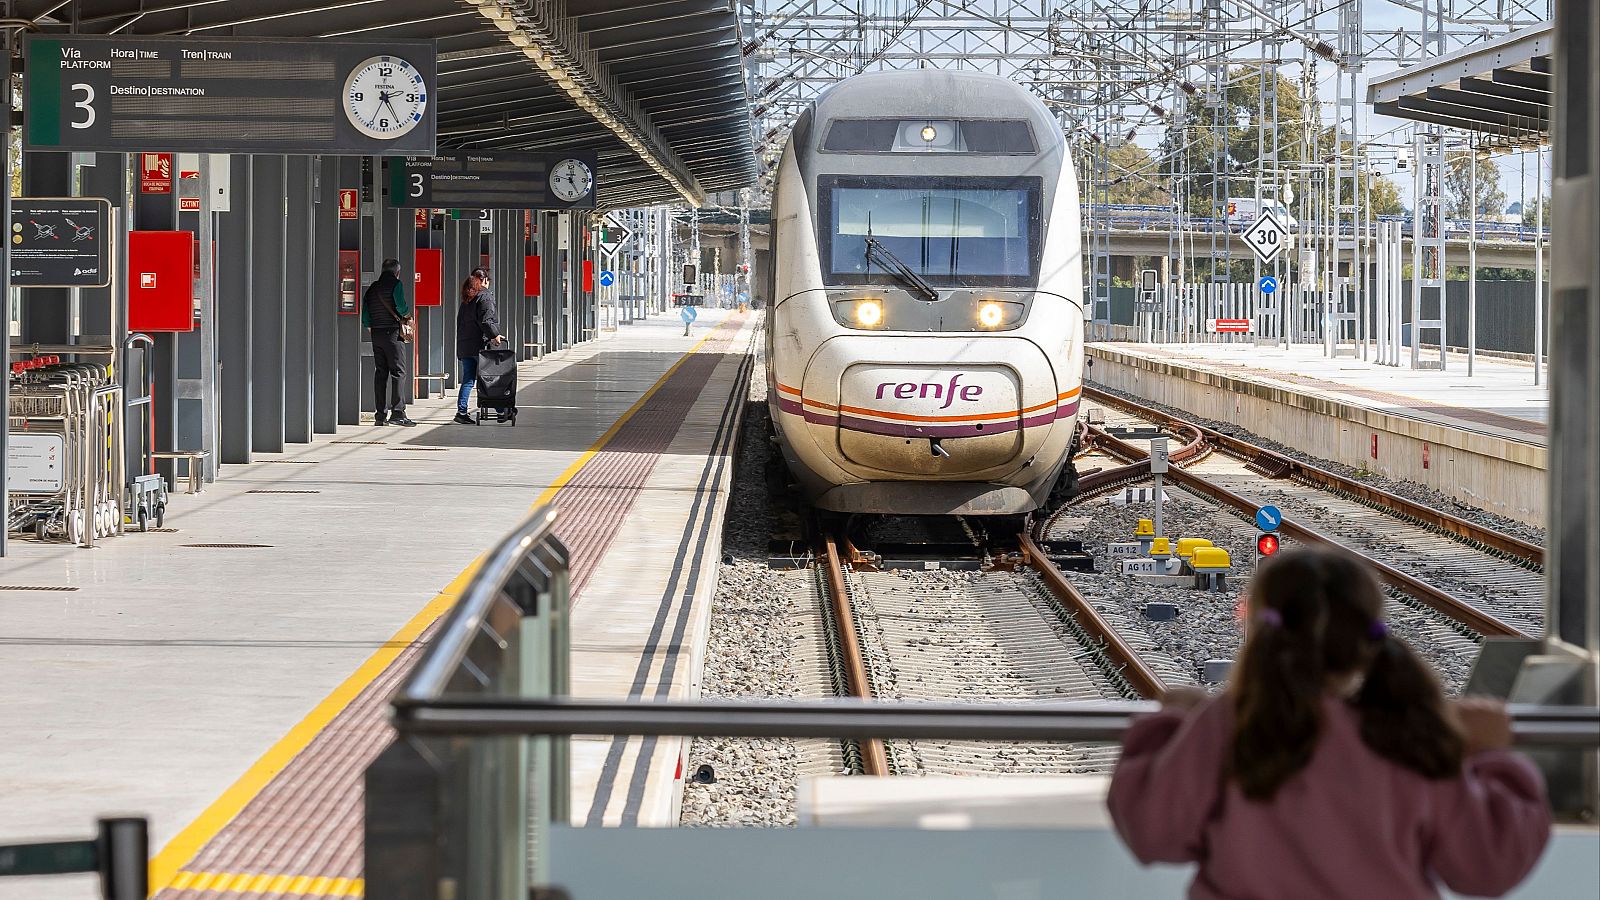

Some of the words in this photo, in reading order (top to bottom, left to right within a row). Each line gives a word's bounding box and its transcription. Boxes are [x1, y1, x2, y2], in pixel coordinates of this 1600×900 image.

[61, 47, 81, 59] Vía
[60, 61, 112, 69] PLATFORM
[377, 67, 393, 78] 12
[354, 92, 364, 102] 9
[405, 93, 415, 103] 3
[70, 83, 96, 129] 3
[379, 118, 389, 128] 6
[410, 173, 424, 198] 3
[1257, 229, 1278, 245] 30
[875, 373, 983, 409] renfe
[1113, 546, 1124, 554] AG
[1126, 546, 1137, 554] 1.2
[1128, 563, 1139, 571] AG
[1142, 563, 1153, 571] 1.1
